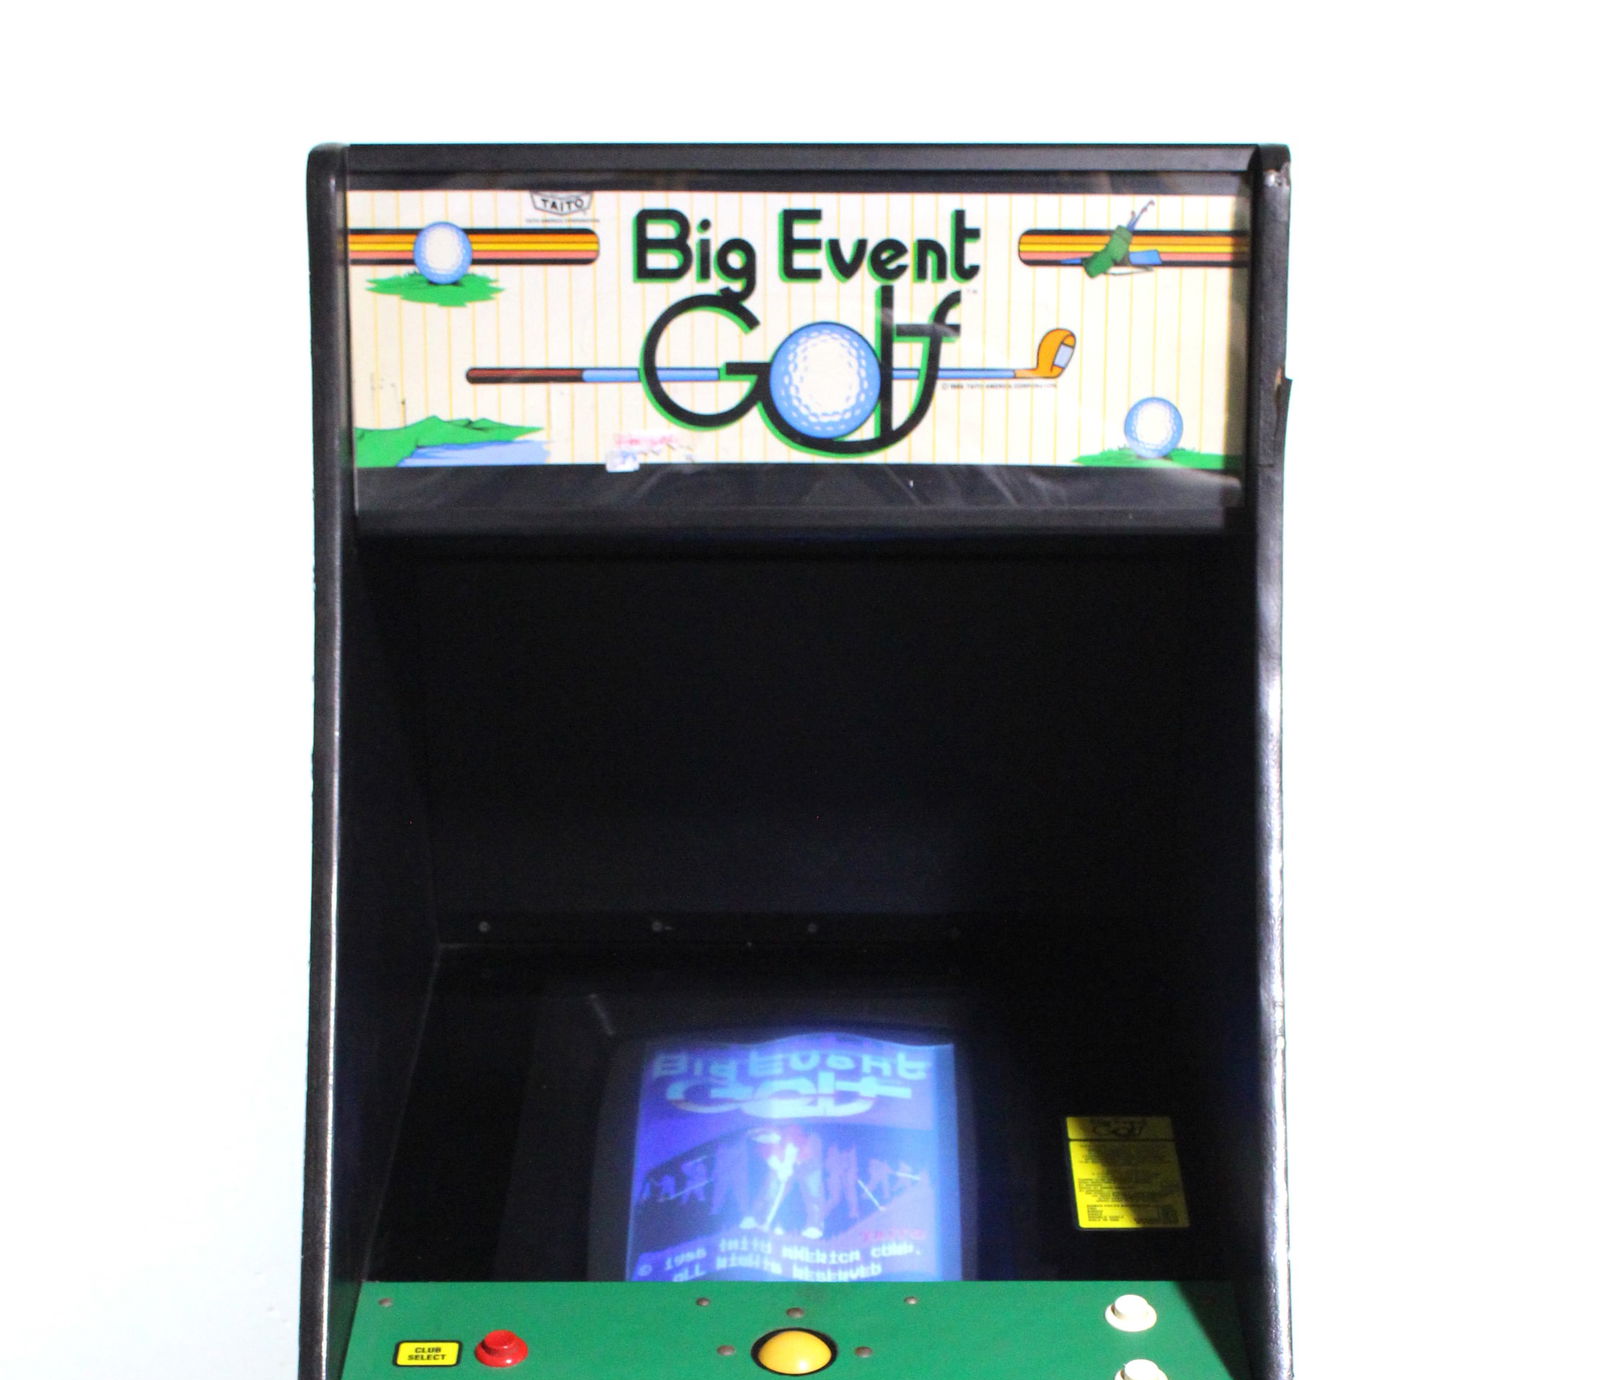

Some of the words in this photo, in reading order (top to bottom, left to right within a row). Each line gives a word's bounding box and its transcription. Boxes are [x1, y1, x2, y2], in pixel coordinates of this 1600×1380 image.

[541, 198, 584, 212] TAITO
[633, 208, 757, 302] Big
[778, 208, 981, 284] Event
[640, 284, 962, 459] Golf
[651, 1051, 738, 1083] Big
[414, 1346, 442, 1354] CLUB
